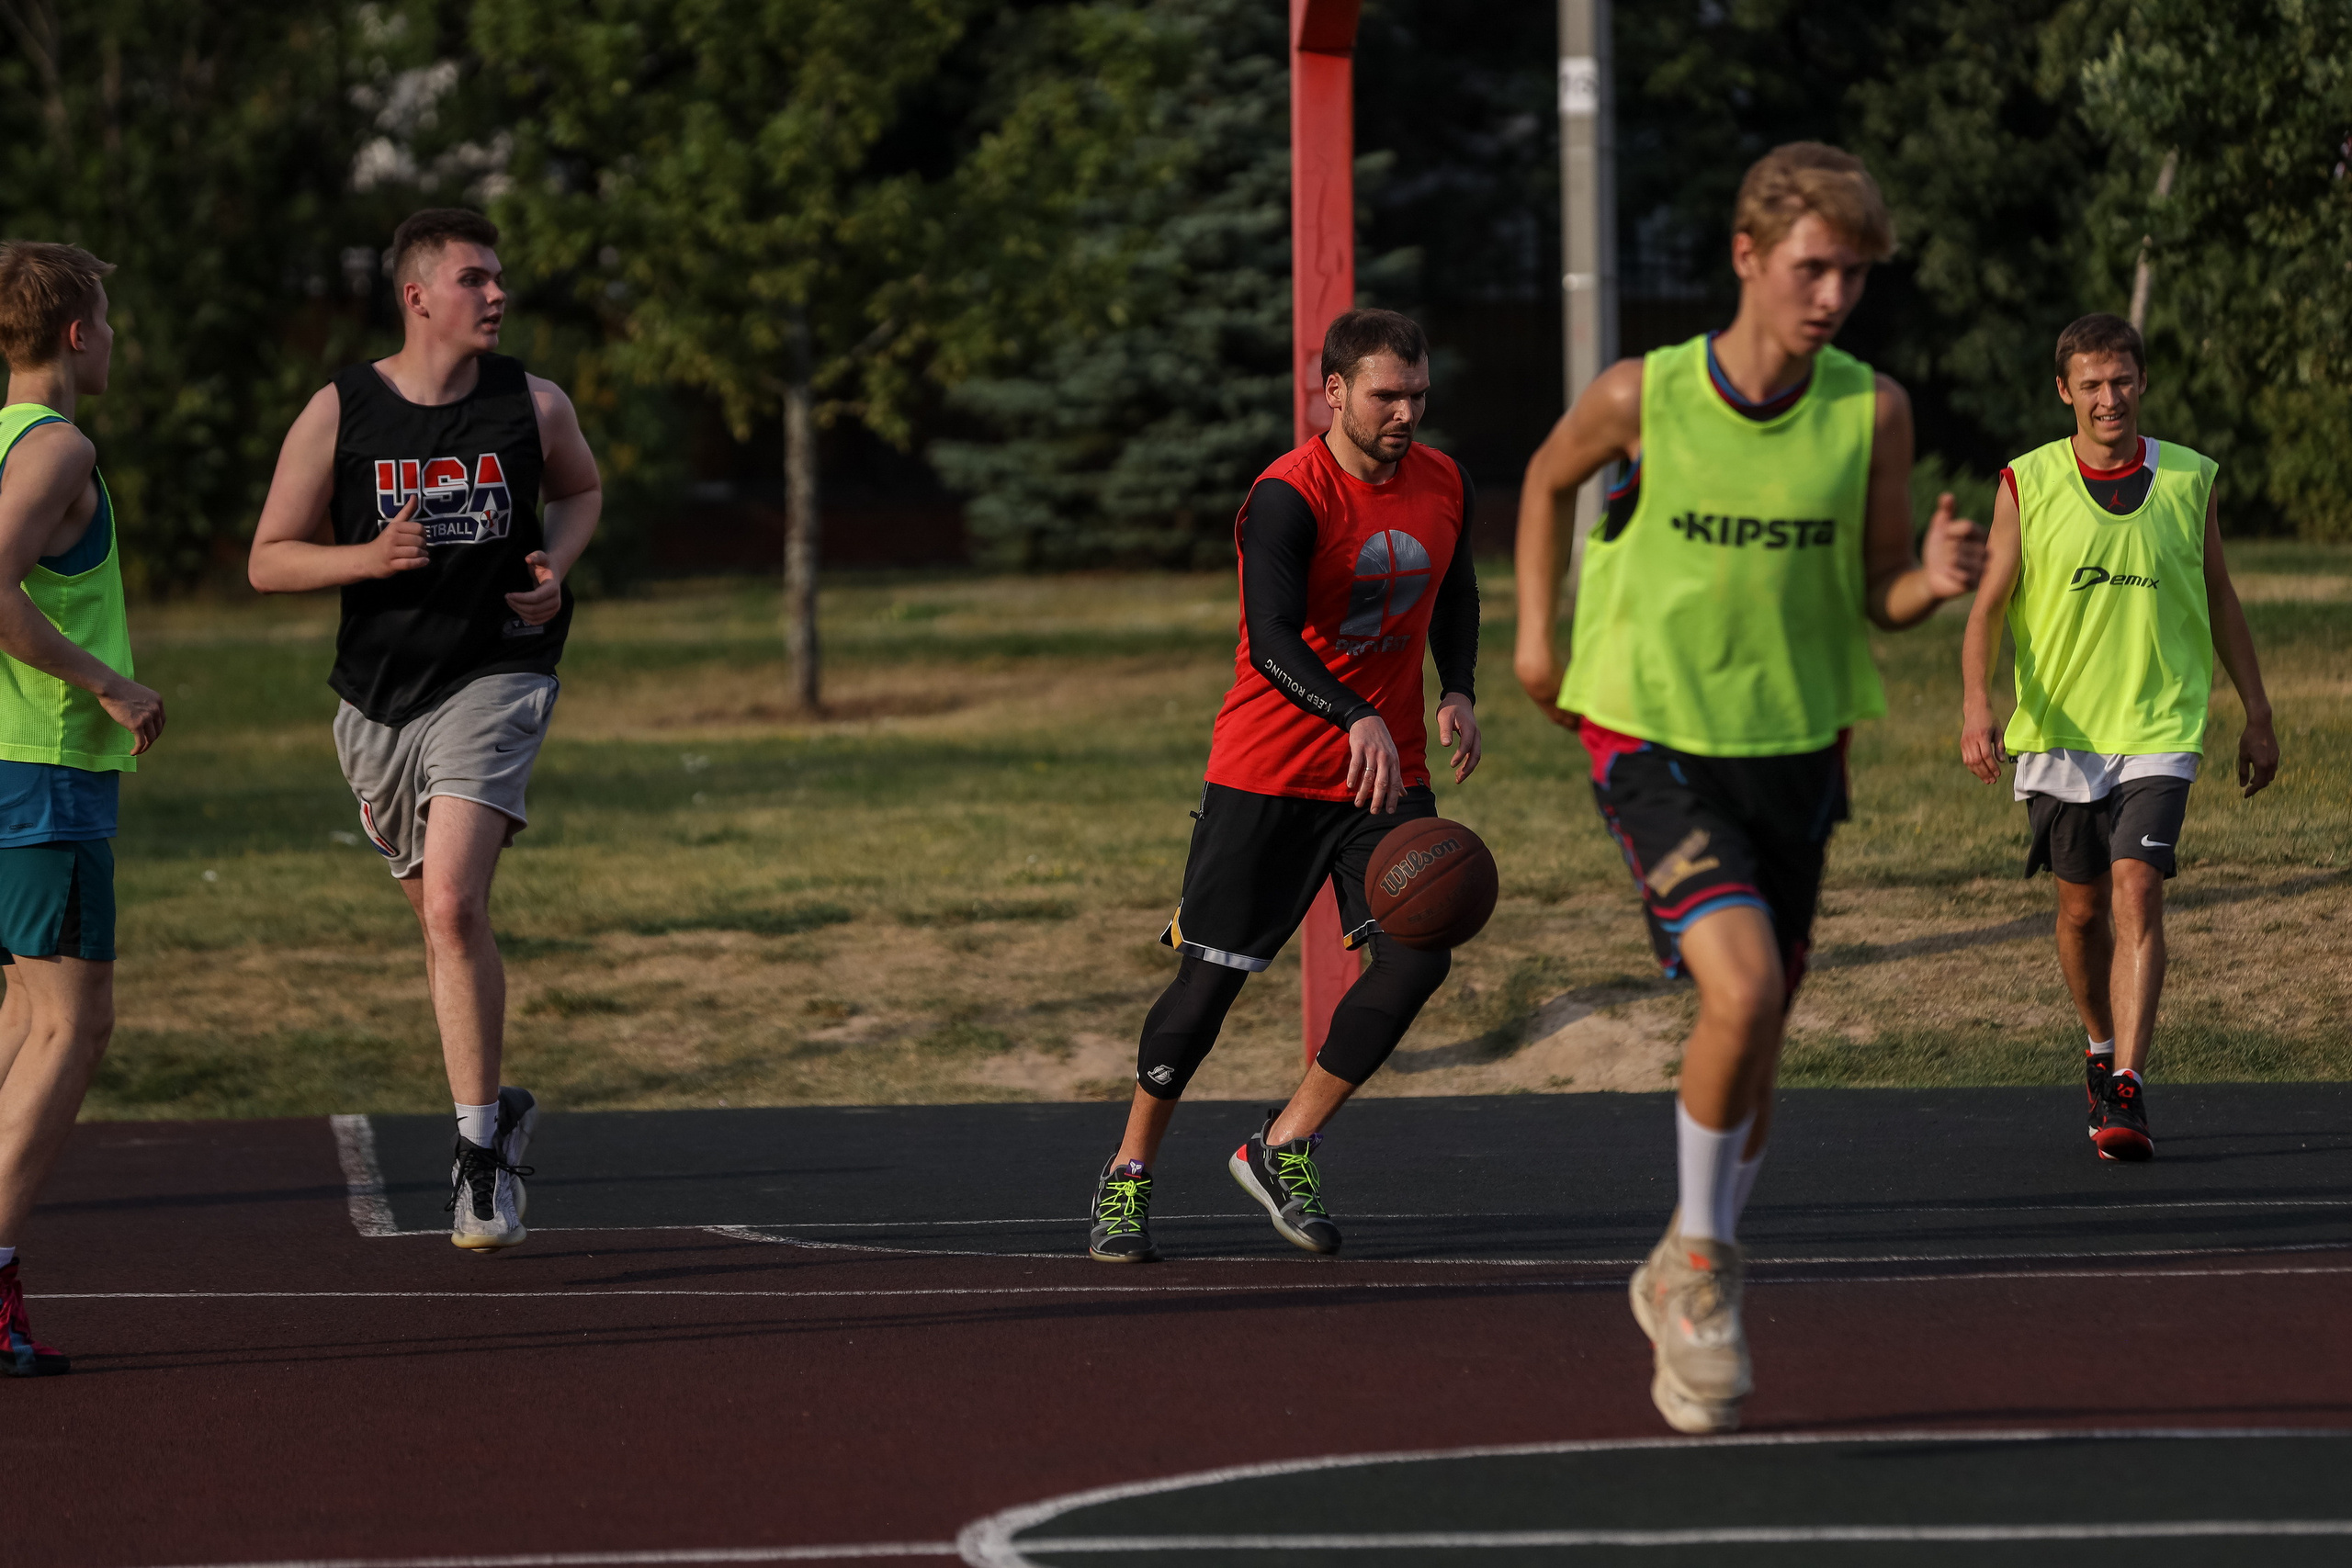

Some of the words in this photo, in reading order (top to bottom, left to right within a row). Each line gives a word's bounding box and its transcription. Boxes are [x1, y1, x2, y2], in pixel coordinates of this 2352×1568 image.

[374, 453, 512, 521] USA
[424, 522, 474, 538] ETBALL
[1264, 659, 1306, 698] ROLLING
[1306, 693, 1332, 713] KEEP
[1379, 837, 1463, 897] Wilson
